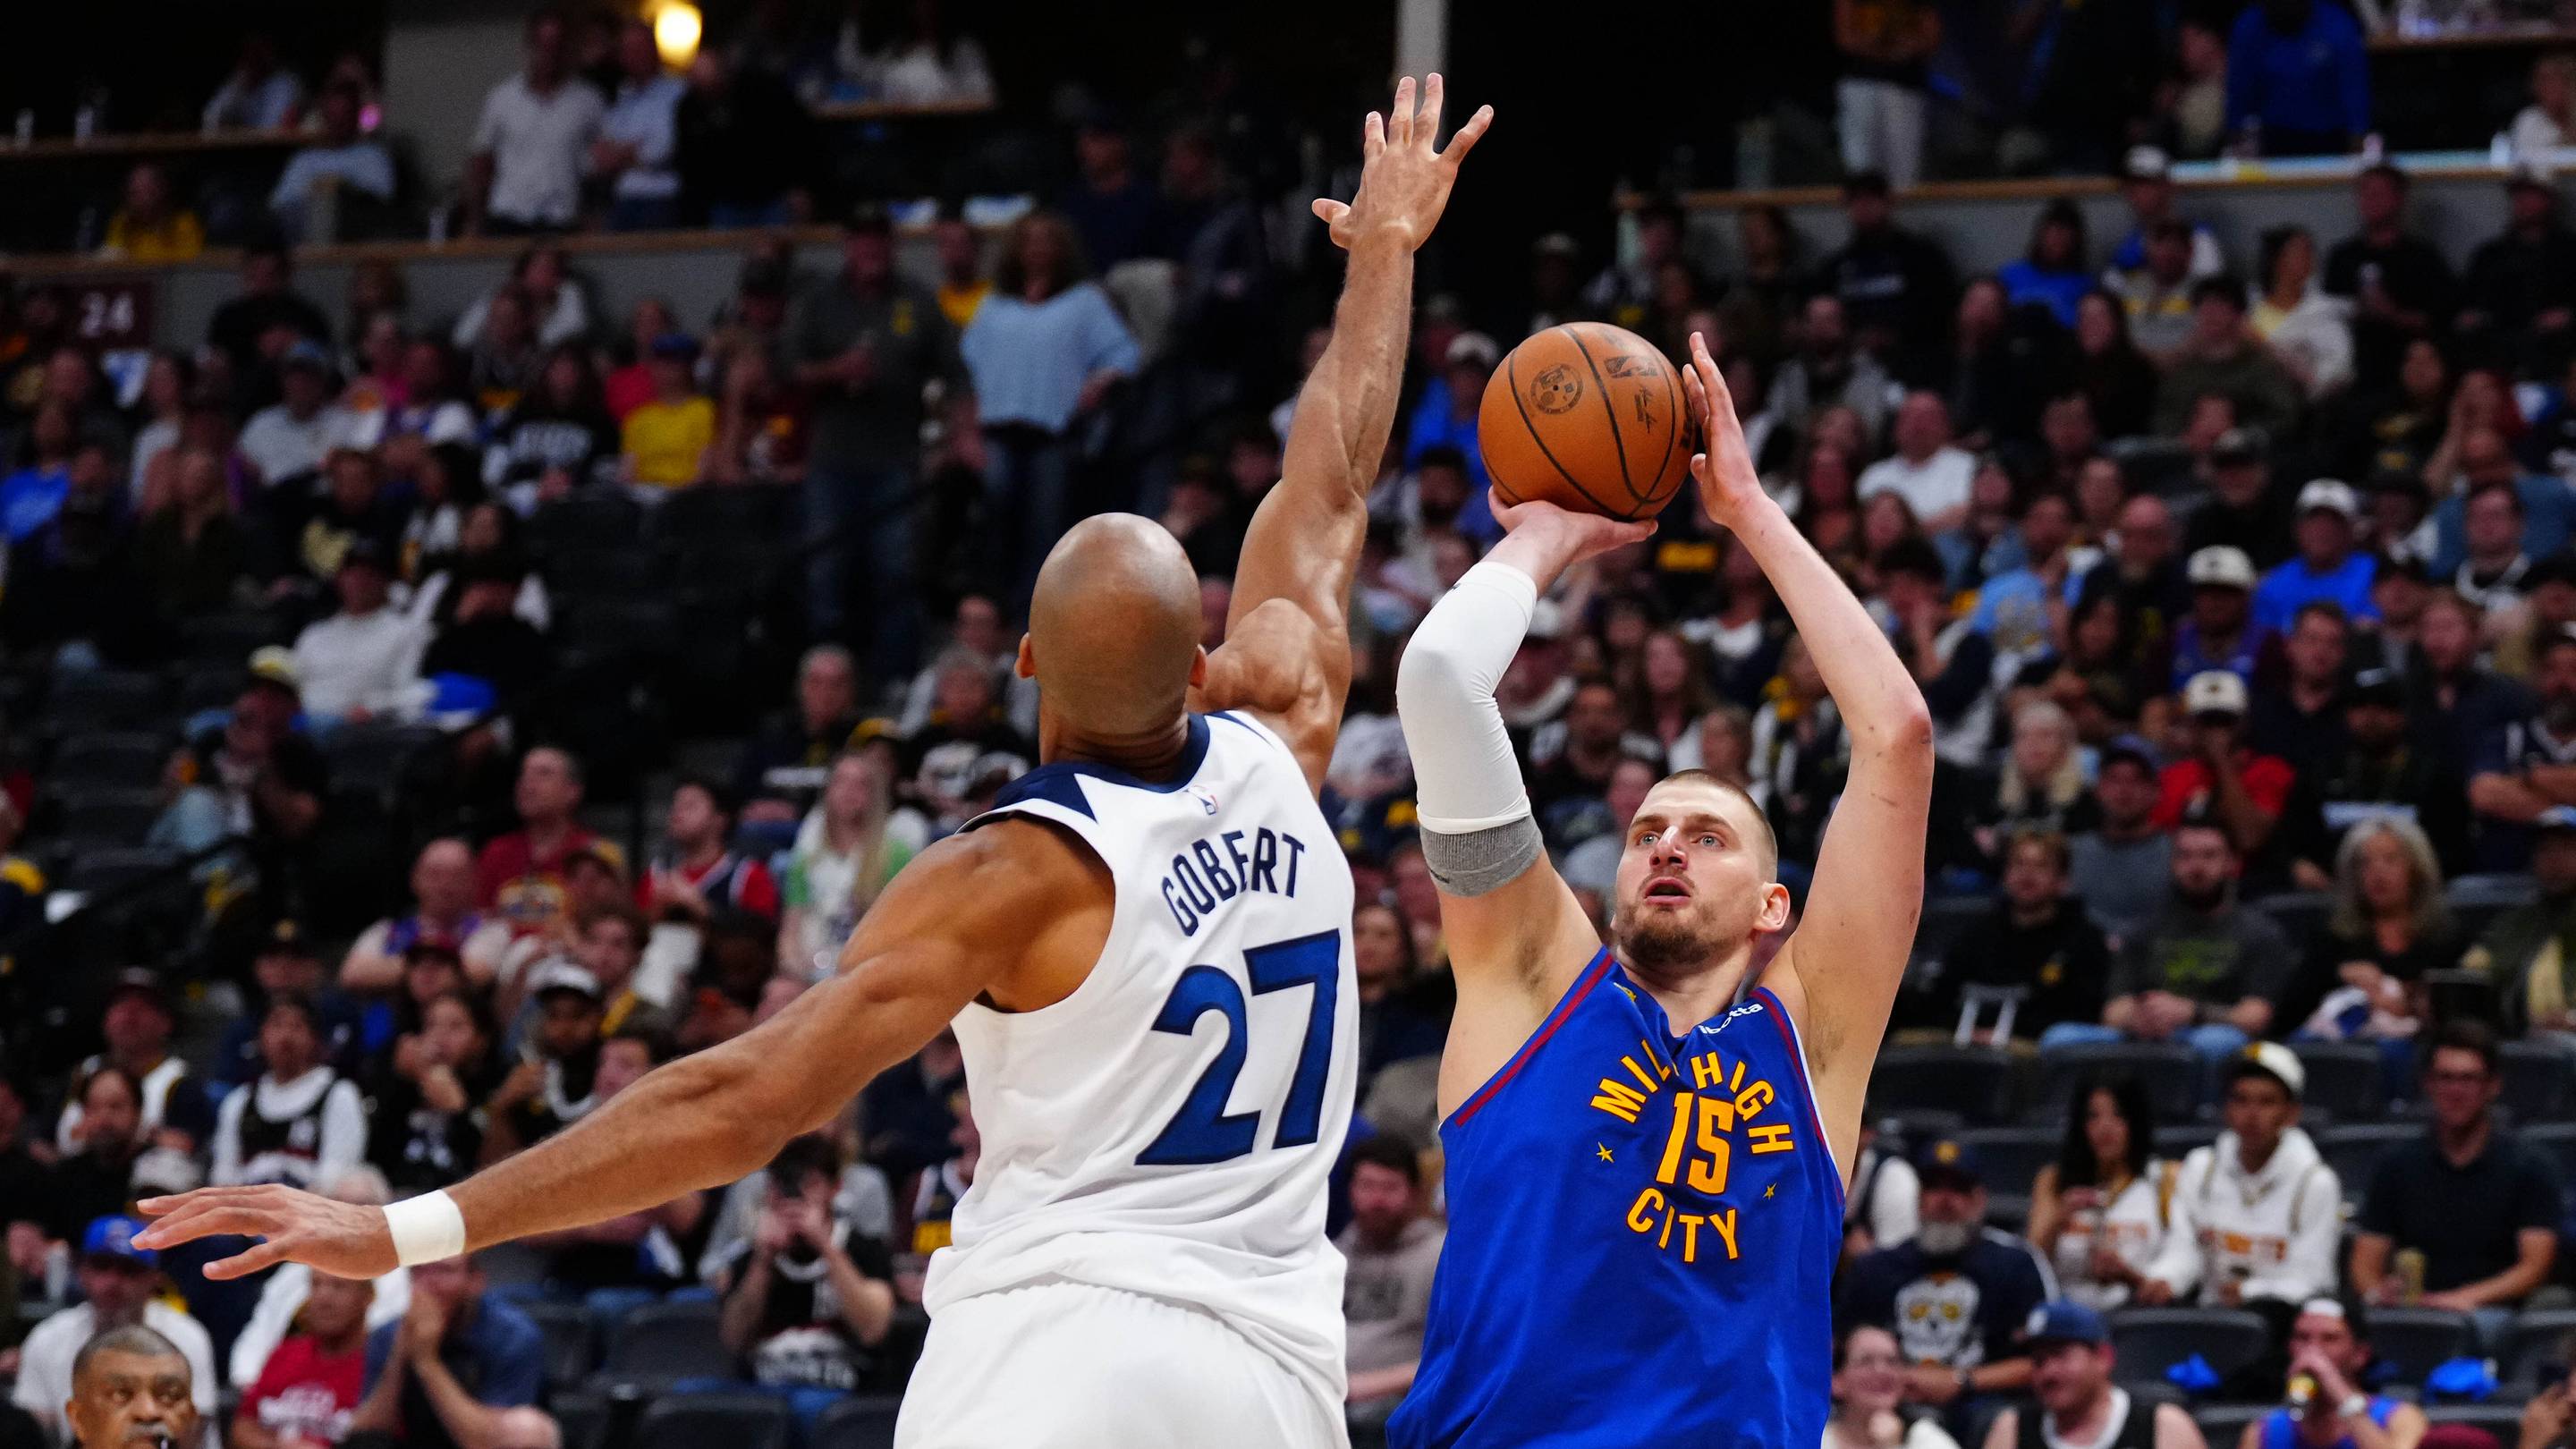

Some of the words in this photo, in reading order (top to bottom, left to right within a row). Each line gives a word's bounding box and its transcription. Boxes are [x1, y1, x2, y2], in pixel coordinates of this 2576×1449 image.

[1161, 826, 1305, 937] GOBERT
[1134, 928, 1341, 1165] 27
[1589, 1039, 1680, 1124] MIL
[1690, 1051, 1794, 1155] HIGH
[1656, 1091, 1735, 1195] 15
[1626, 1187, 1739, 1263] CITY
